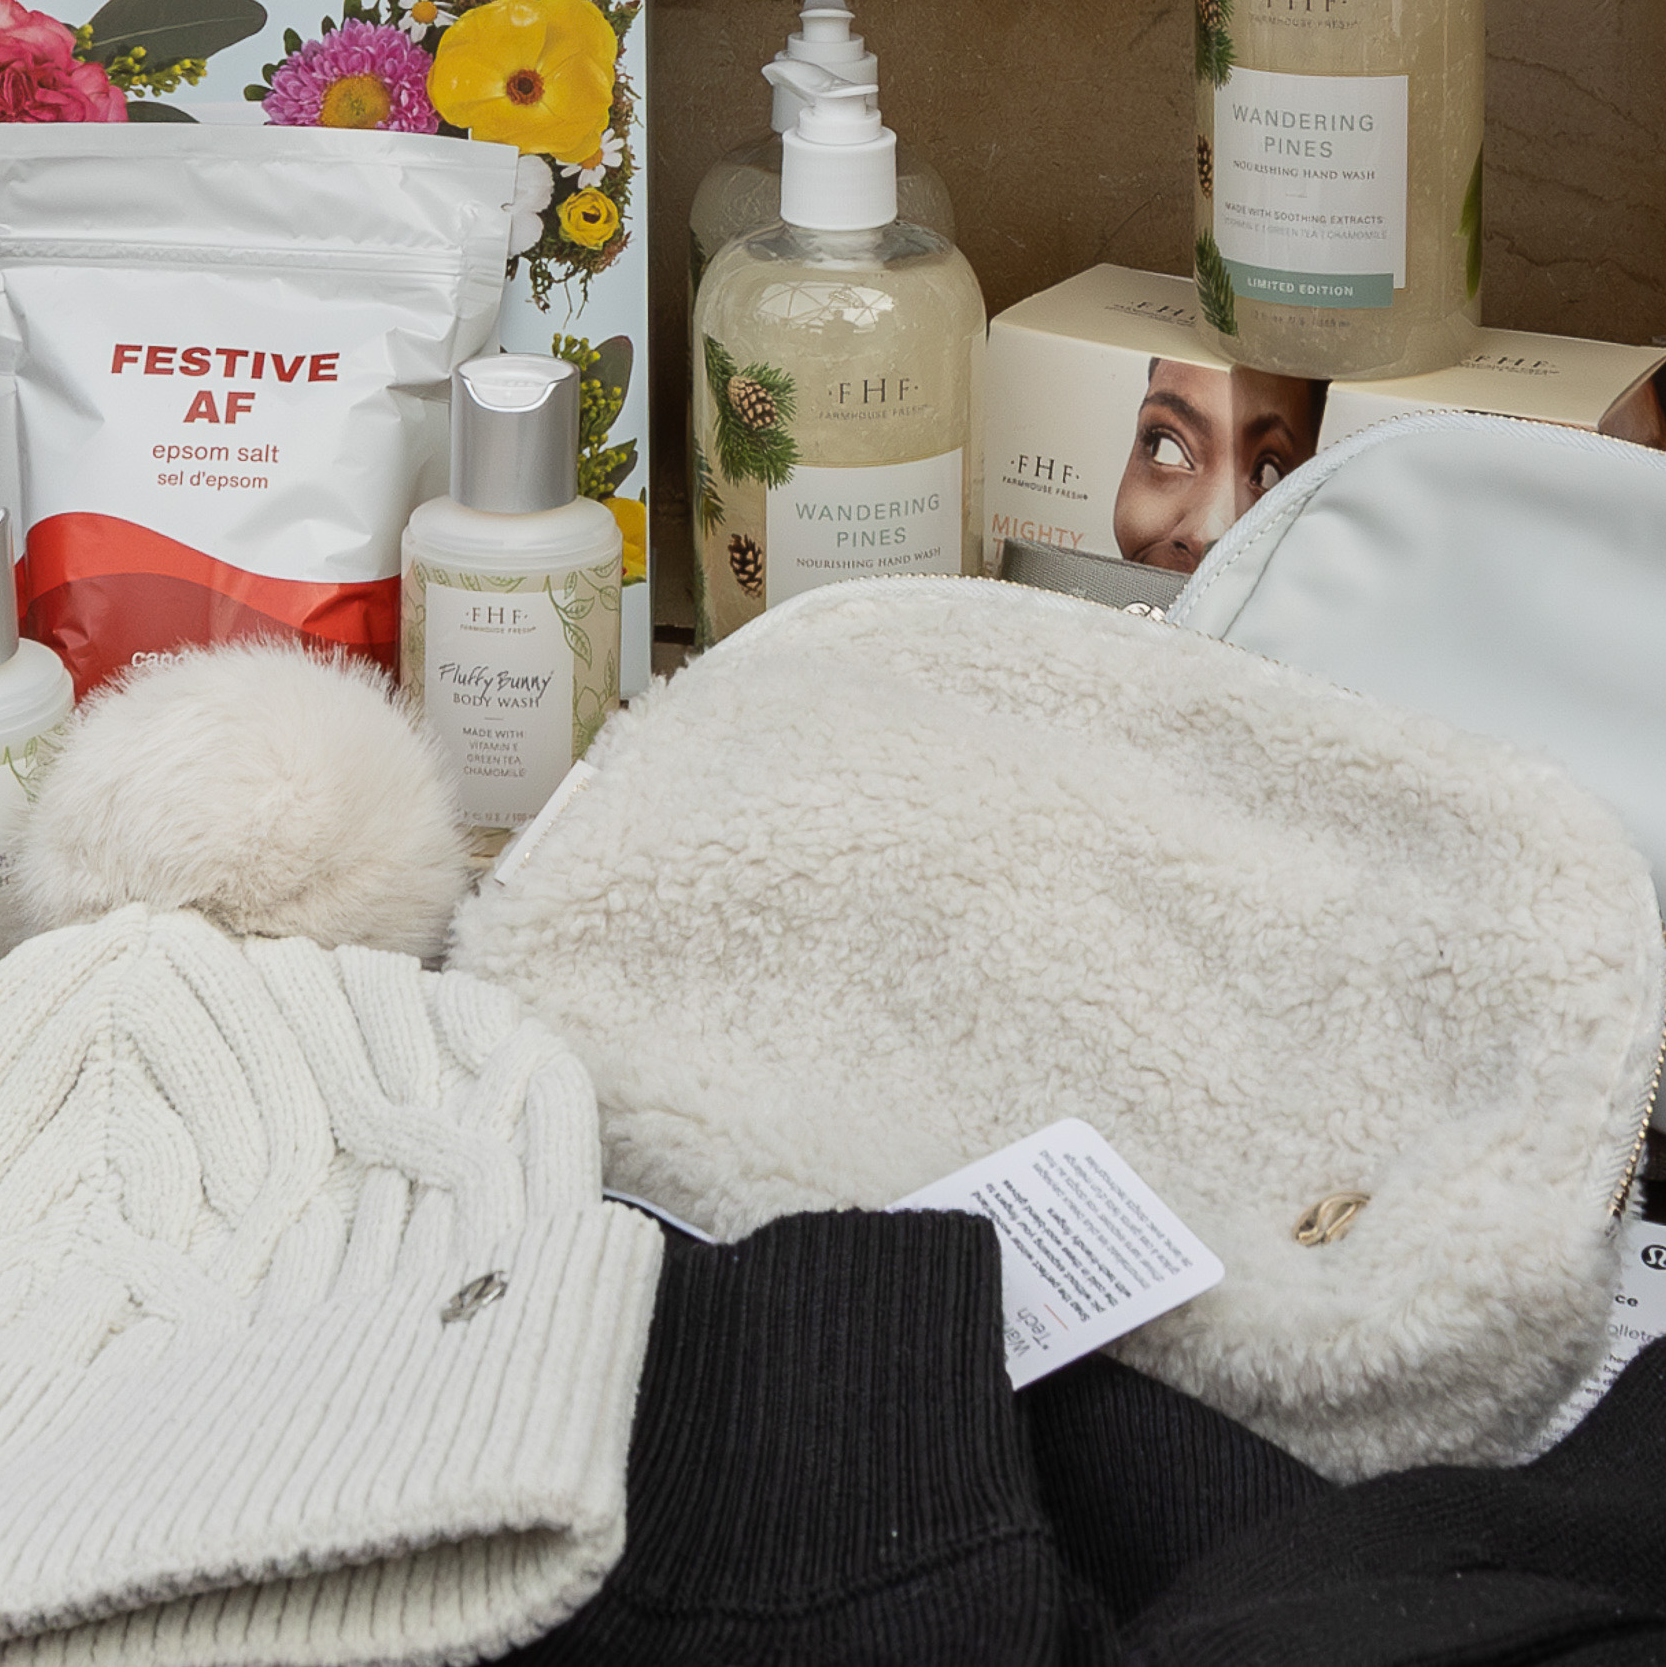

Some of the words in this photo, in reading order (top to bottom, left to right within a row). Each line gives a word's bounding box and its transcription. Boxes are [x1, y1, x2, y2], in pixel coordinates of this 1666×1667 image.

[1232, 103, 1374, 132] WANDERING
[1263, 136, 1333, 159] PINES
[1233, 160, 1298, 177] NOURISHING
[1303, 169, 1338, 180] HAND
[1341, 170, 1376, 180] WASH
[1225, 202, 1247, 215] MADE
[1274, 212, 1326, 225] SOOTHING
[1330, 215, 1384, 225] EXTRACTS
[1247, 277, 1294, 293] LIMITED
[1299, 283, 1354, 297] EDITION
[111, 343, 340, 383] FESTIVE
[840, 378, 911, 404] FHF
[183, 390, 256, 425] AF
[152, 443, 229, 463] epsom
[237, 443, 279, 463] salt
[157, 470, 183, 486] sel
[189, 472, 269, 491] d'epsom
[1017, 454, 1074, 484] FHF
[1002, 476, 1054, 494] FARMHOUSE
[1056, 488, 1088, 502] FRESH
[796, 493, 940, 521] WANDERING
[837, 527, 907, 548] PINES
[992, 513, 1083, 549] MIGHTY
[796, 557, 874, 569] NOURISHING
[878, 554, 911, 568] HAND
[914, 547, 941, 562] WASH
[472, 605, 523, 625] FHF
[439, 662, 494, 699] Fluffy
[496, 670, 554, 700] Bunny
[453, 692, 492, 707] BODY
[497, 696, 541, 708] WASH
[462, 727, 493, 738] MADE
[495, 729, 524, 739] WITH
